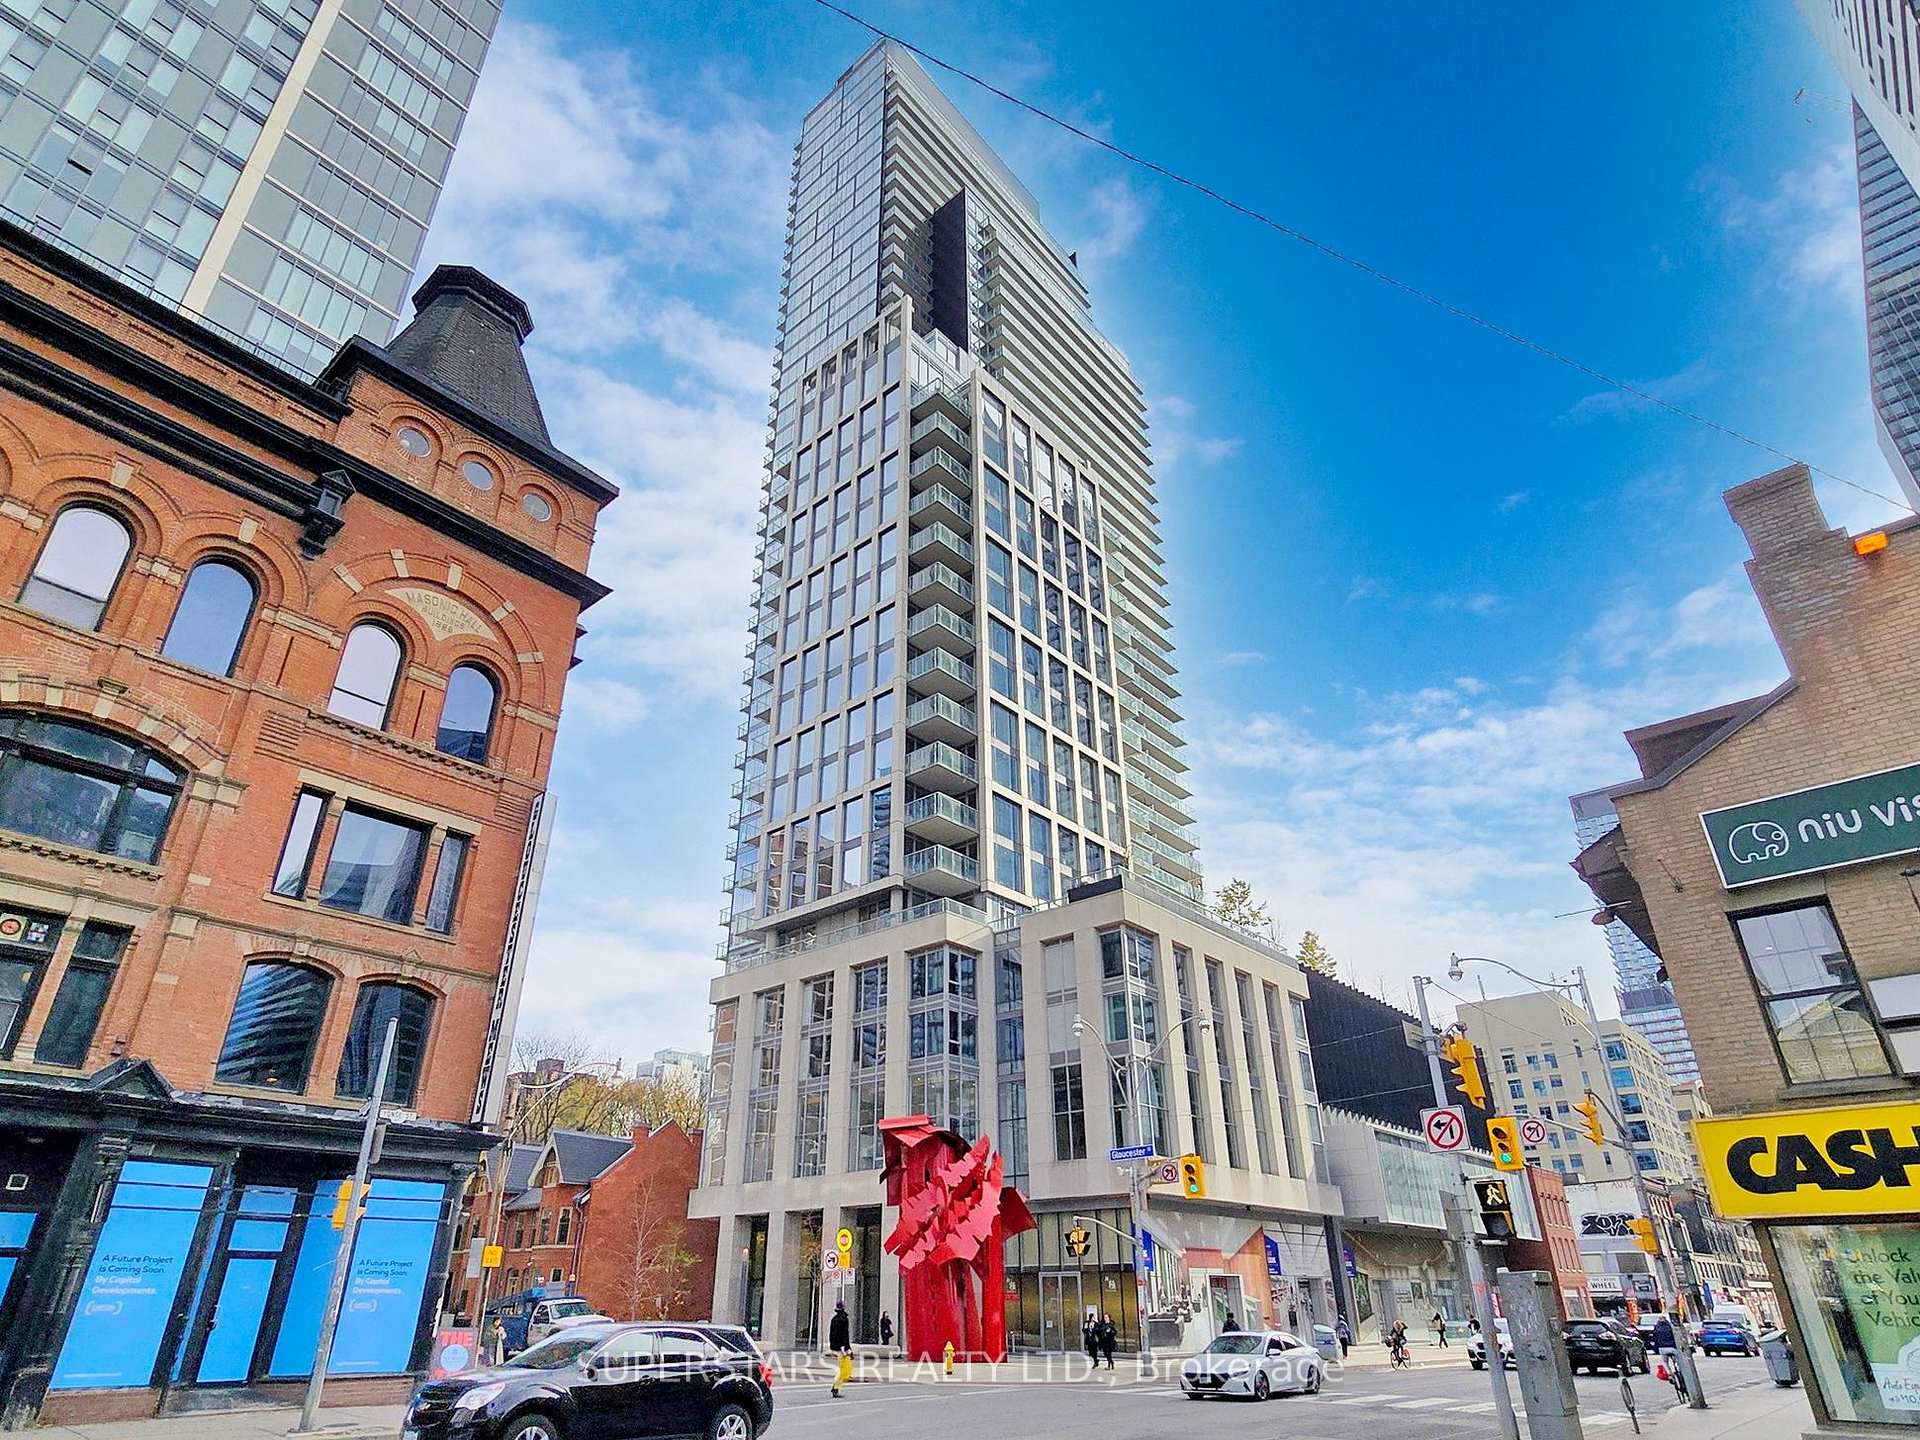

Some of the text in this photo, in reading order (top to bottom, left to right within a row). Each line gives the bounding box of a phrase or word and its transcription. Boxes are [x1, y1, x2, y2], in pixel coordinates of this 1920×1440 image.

[406, 591, 482, 633] MASONIC HALL
[1798, 808, 1862, 842] niu
[1111, 1149, 1146, 1159] Gloucester
[1726, 1126, 1920, 1194] CASH
[103, 1254, 174, 1265] A Future Project
[107, 1265, 141, 1276] Coming
